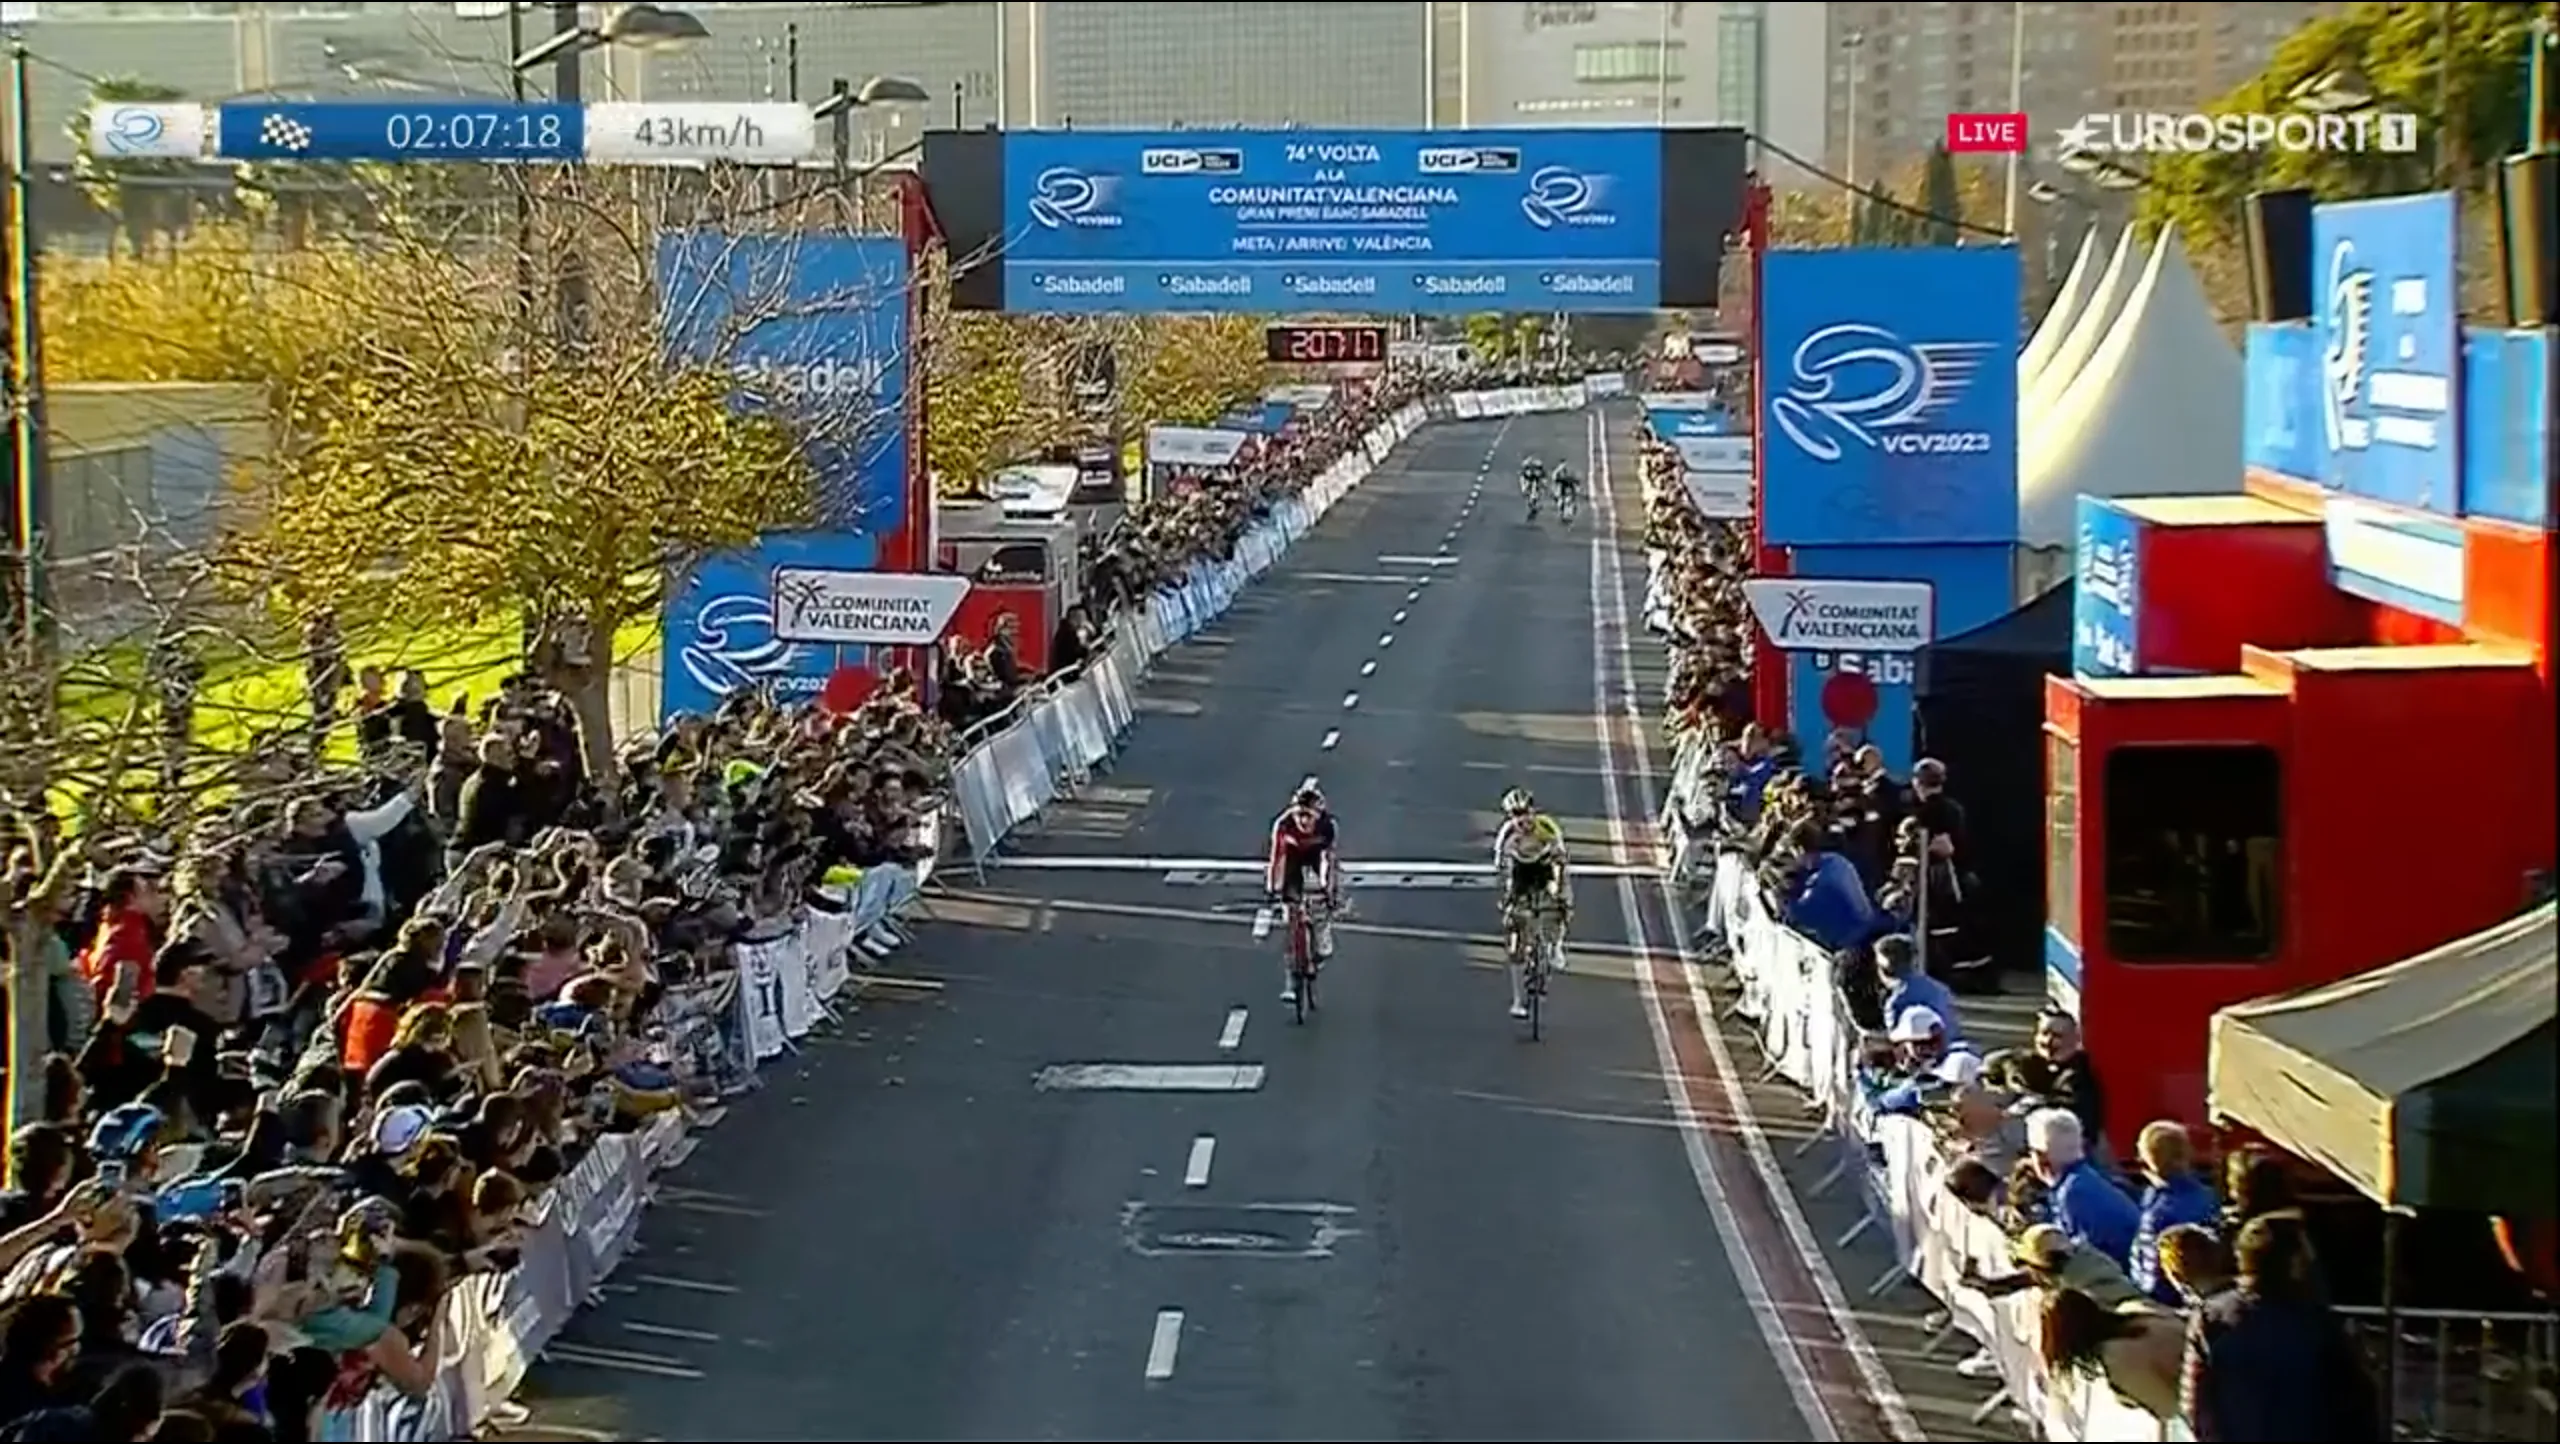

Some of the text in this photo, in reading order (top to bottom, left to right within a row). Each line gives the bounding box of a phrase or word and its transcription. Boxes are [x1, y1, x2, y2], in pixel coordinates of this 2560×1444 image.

[1147, 153, 1180, 168] UCI
[1318, 144, 1380, 162] VOLTA
[1423, 153, 1457, 168] UCI
[1314, 169, 1345, 182] A LA
[1208, 186, 1459, 204] COMUNITAT VALENCIANA
[1232, 237, 1275, 252] META
[1043, 275, 1125, 294] Sabadell
[1171, 275, 1252, 294] Sabadell
[1294, 275, 1376, 294] Sabadell
[1425, 275, 1506, 295] Sabadell
[1552, 274, 1634, 294] Sabadell
[1881, 432, 1992, 453] VCV2023
[829, 596, 931, 613] COMUNITAT
[1818, 605, 1920, 619] COMUNITAT
[807, 613, 931, 632] VALENCIANA
[1795, 622, 1921, 638] VALENCIANA
